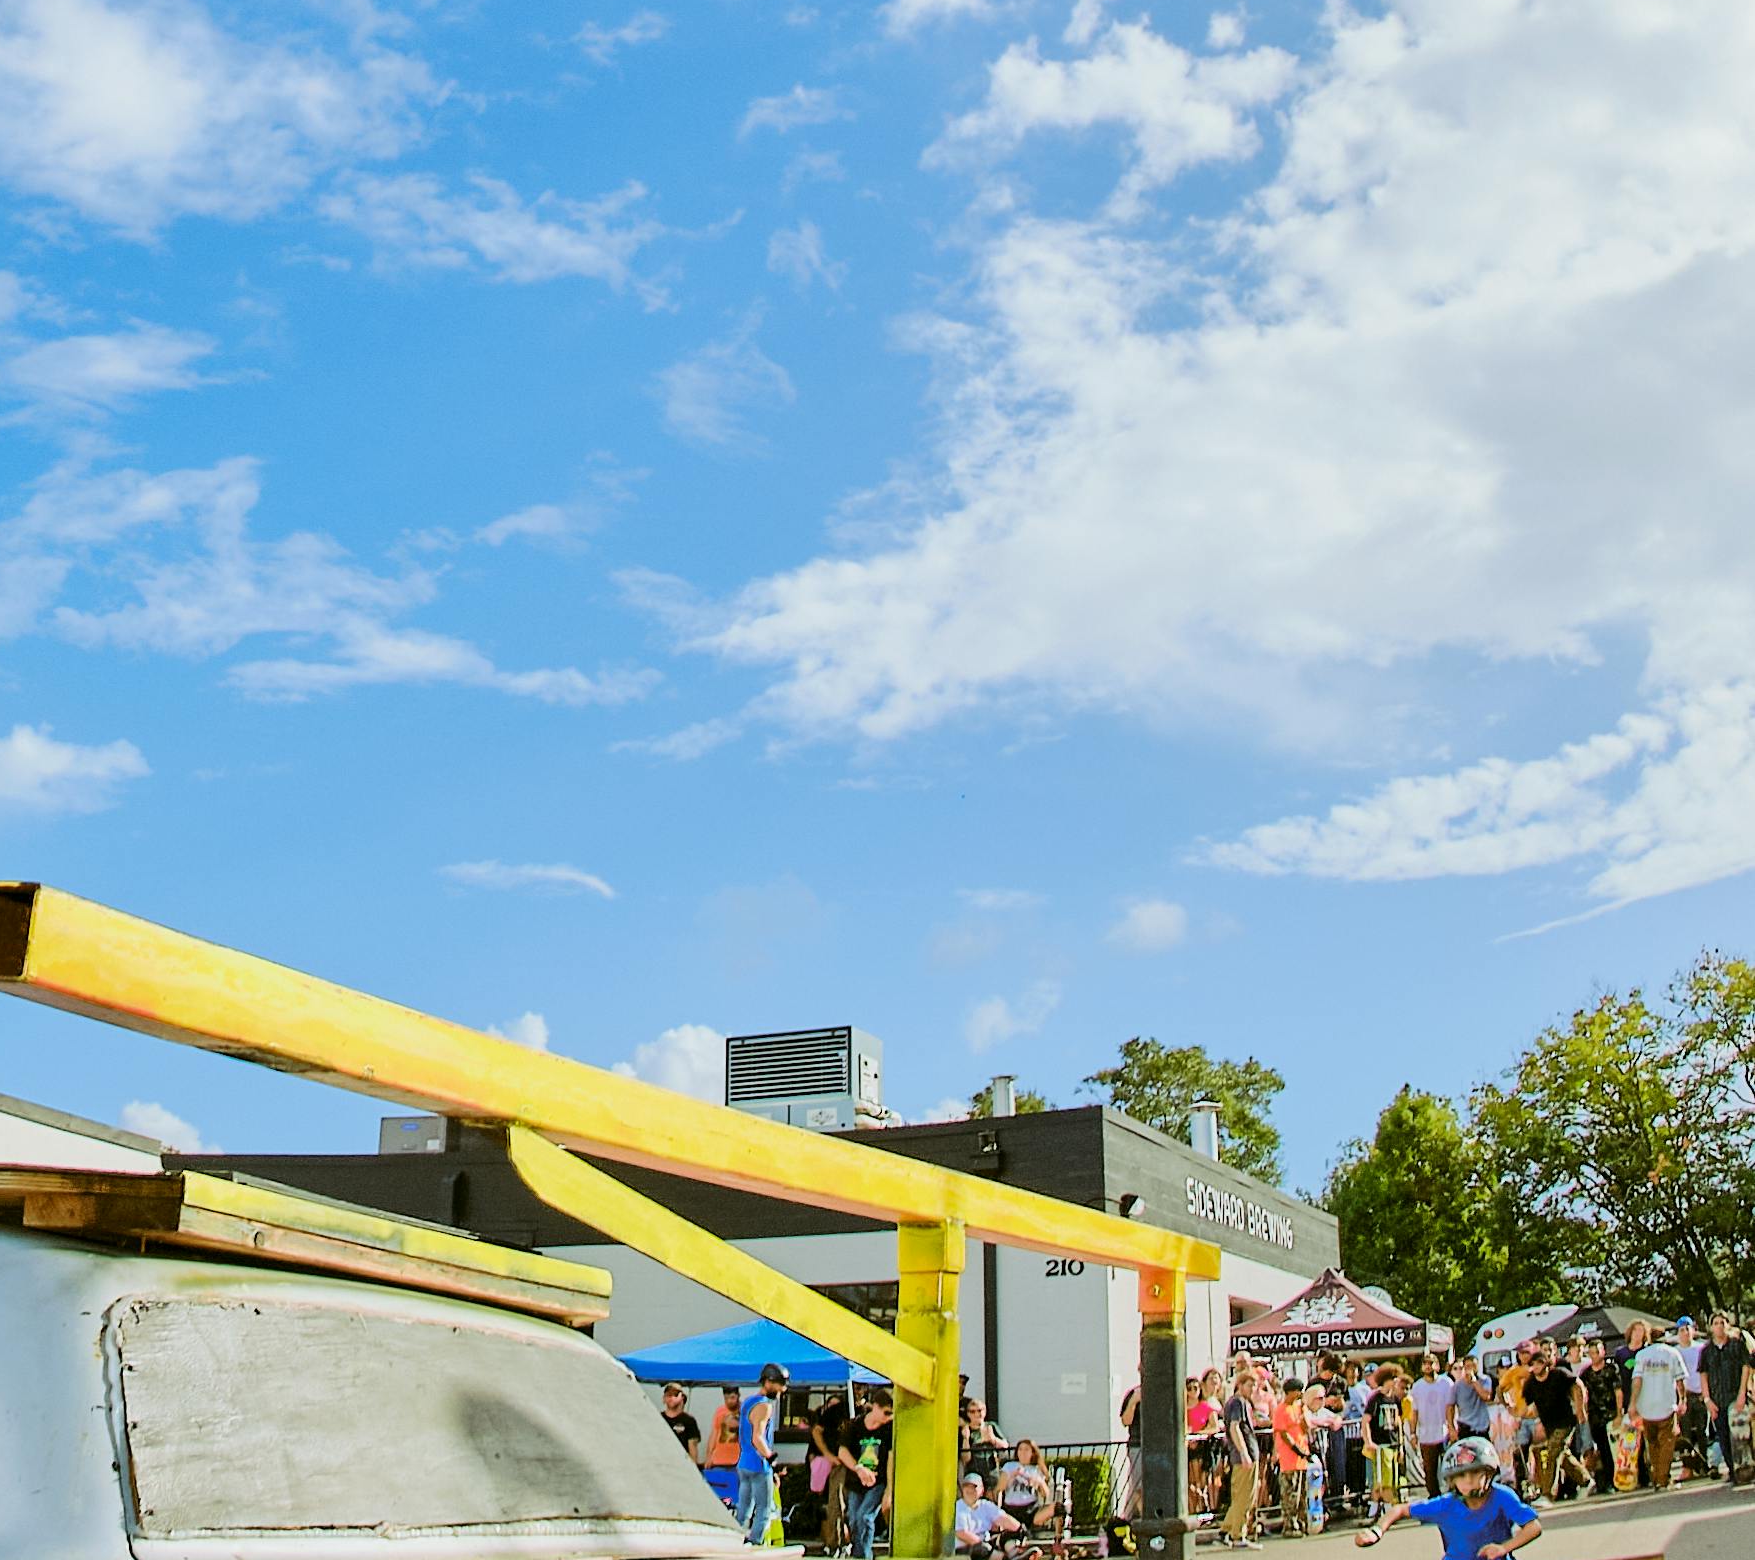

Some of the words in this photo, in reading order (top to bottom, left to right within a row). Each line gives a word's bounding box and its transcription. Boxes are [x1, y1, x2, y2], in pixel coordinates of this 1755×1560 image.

[1186, 1176, 1245, 1231] SIDEWARD
[1247, 1201, 1294, 1250] BREWING
[1046, 1259, 1085, 1277] 210
[1232, 1333, 1311, 1351] IDEWARD
[1317, 1328, 1406, 1348] BREWING
